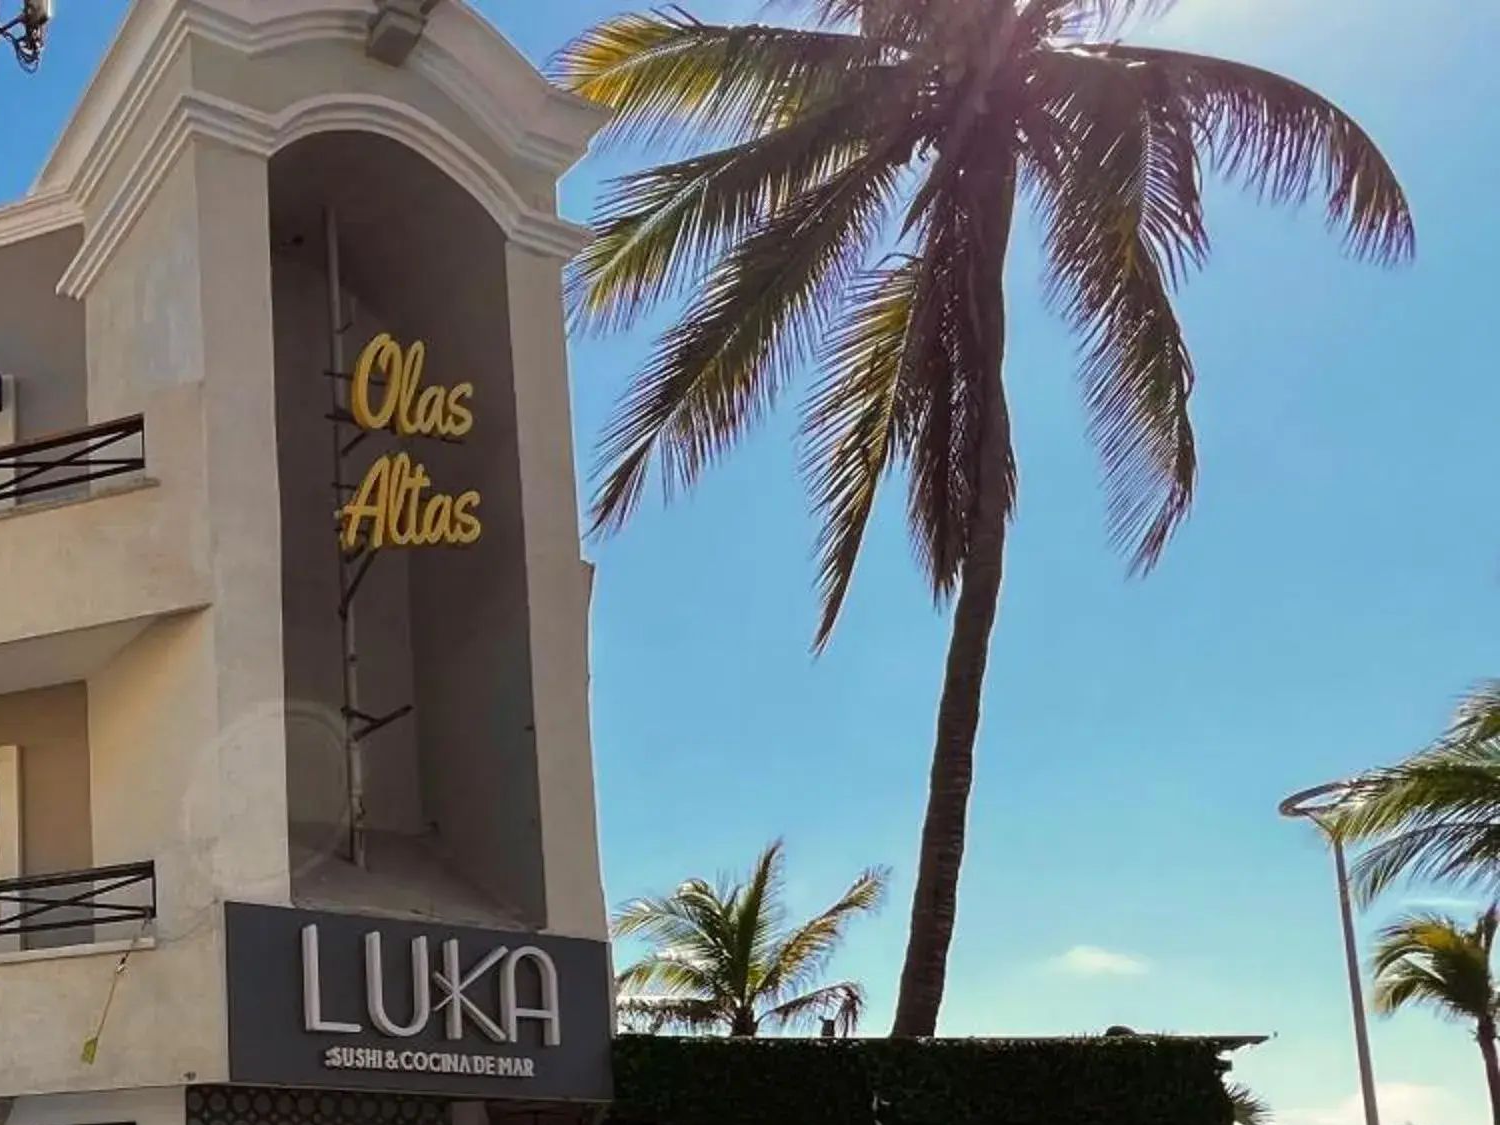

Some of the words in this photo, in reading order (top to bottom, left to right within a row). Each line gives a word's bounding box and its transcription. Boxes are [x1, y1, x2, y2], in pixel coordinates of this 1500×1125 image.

[351, 333, 474, 437] Olas
[342, 452, 482, 549] Altas
[301, 923, 561, 1047] LUKA
[325, 1046, 382, 1068] SUSHI
[399, 1051, 471, 1073] COCINA
[473, 1056, 495, 1075] DE
[498, 1057, 536, 1077] MAR
